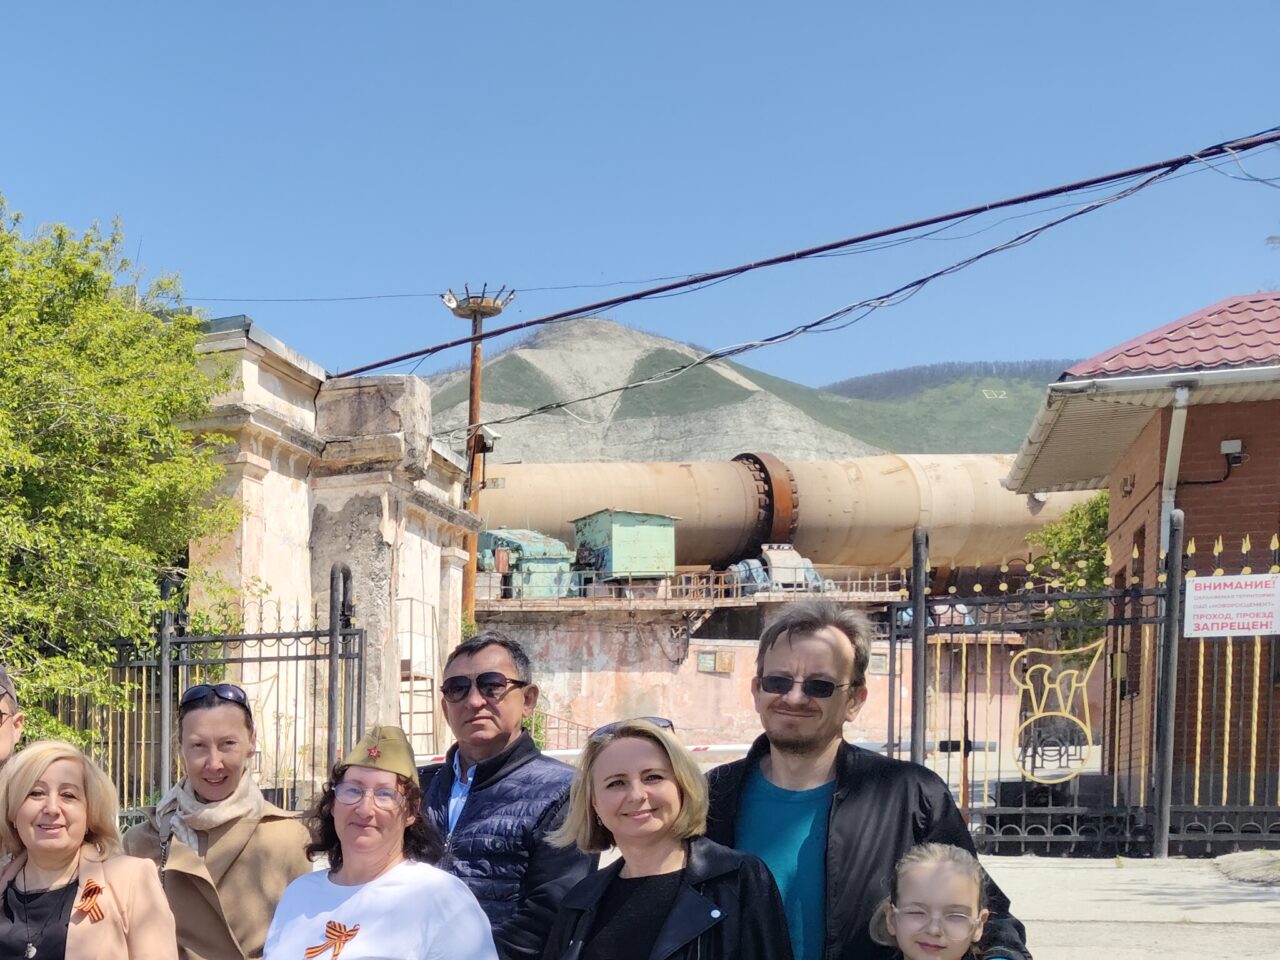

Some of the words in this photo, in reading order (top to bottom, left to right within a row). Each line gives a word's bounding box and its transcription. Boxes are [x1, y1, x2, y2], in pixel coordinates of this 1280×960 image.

[1194, 580, 1275, 591] ВНИМАНИЕ!
[1237, 611, 1274, 619] ПРОЕЗД
[1194, 621, 1273, 632] ЗАПРЕЩЕН!
